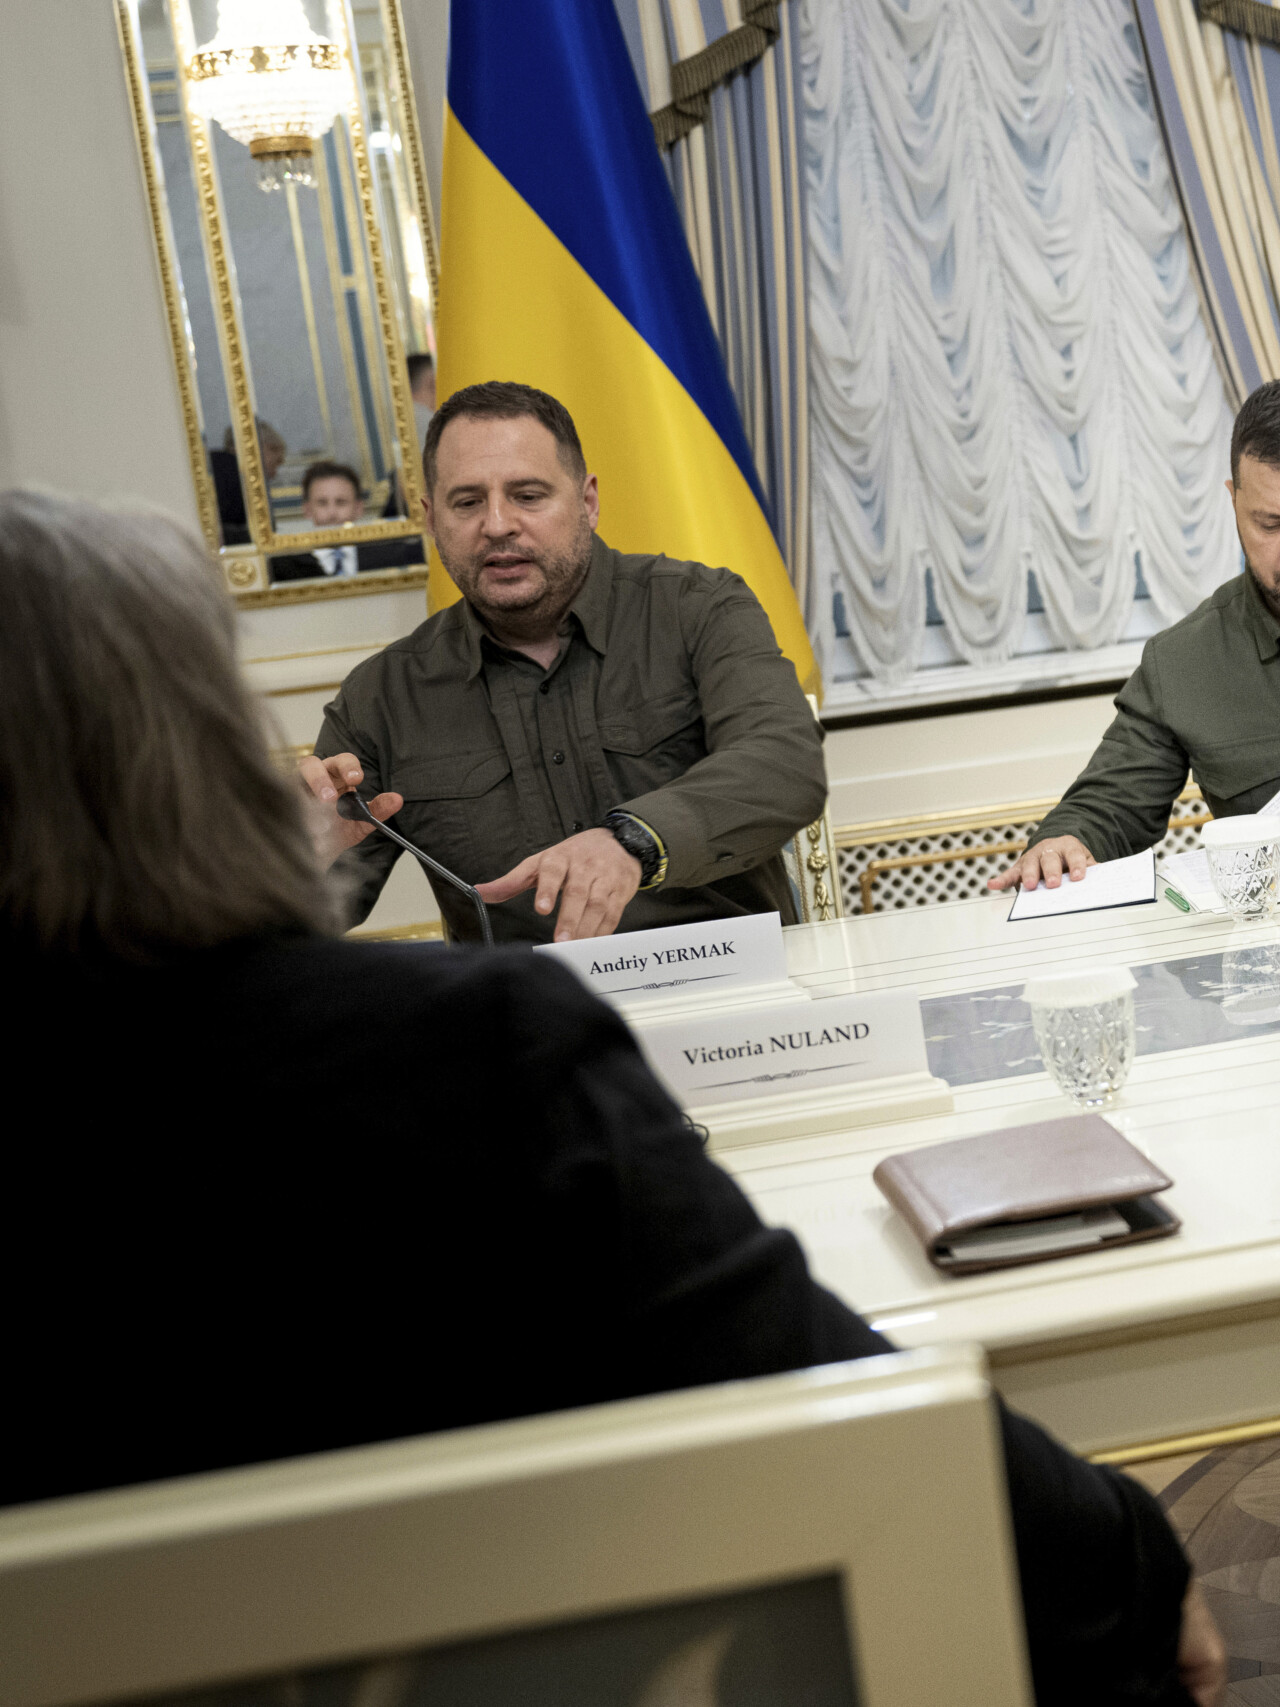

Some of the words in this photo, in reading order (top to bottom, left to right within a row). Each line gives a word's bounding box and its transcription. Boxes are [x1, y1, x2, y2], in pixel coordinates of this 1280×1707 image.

[589, 954, 649, 975] Andriy
[652, 940, 737, 965] YERMAK
[682, 1040, 765, 1066] Victoria
[768, 1022, 871, 1053] NULAND
